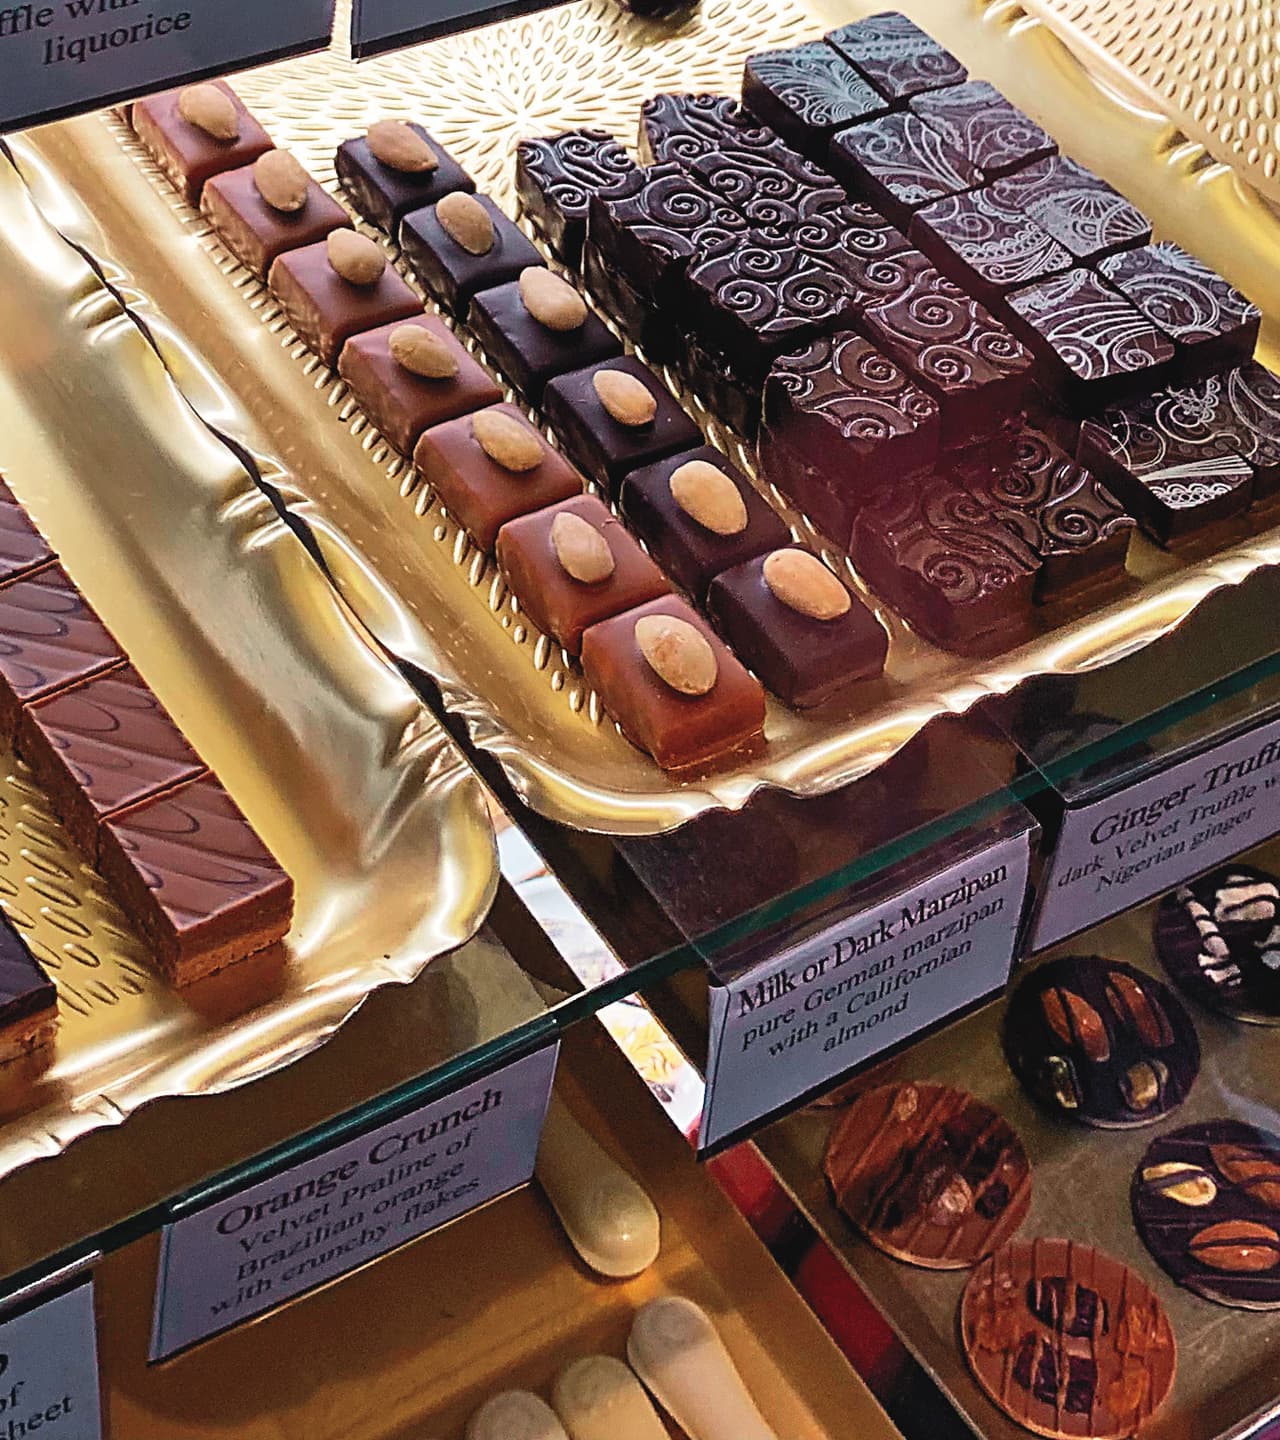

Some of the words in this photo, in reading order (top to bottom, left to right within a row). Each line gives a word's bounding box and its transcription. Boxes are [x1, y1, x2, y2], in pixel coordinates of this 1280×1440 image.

[42, 8, 193, 65] liquorice
[1057, 855, 1105, 888] dark
[1114, 817, 1181, 859] Velvet
[1190, 783, 1258, 825] Truffle
[1090, 782, 1198, 845] Ginger
[1094, 840, 1186, 893] Nigerian
[1189, 806, 1256, 851] ginger
[737, 971, 798, 1018] Milk
[801, 956, 832, 983] or
[832, 919, 895, 967] Dark
[900, 864, 1008, 934] Marzipan
[741, 1007, 796, 1052] pure
[804, 952, 895, 1011] German
[901, 896, 1004, 961] marzipan
[768, 1020, 819, 1056] with
[825, 1013, 838, 1027] a
[846, 938, 972, 1015] Californian
[823, 992, 909, 1053] almond
[216, 1156, 361, 1236] Orange
[367, 1088, 503, 1166] Crunch
[235, 1203, 365, 1281] Brazilian
[373, 1161, 465, 1215] orange
[238, 1204, 331, 1253] Velvet
[342, 1153, 439, 1209] Praline
[444, 1126, 479, 1157] of
[209, 1276, 273, 1316] with
[280, 1224, 394, 1284] crunchy
[402, 1176, 482, 1225] flakes
